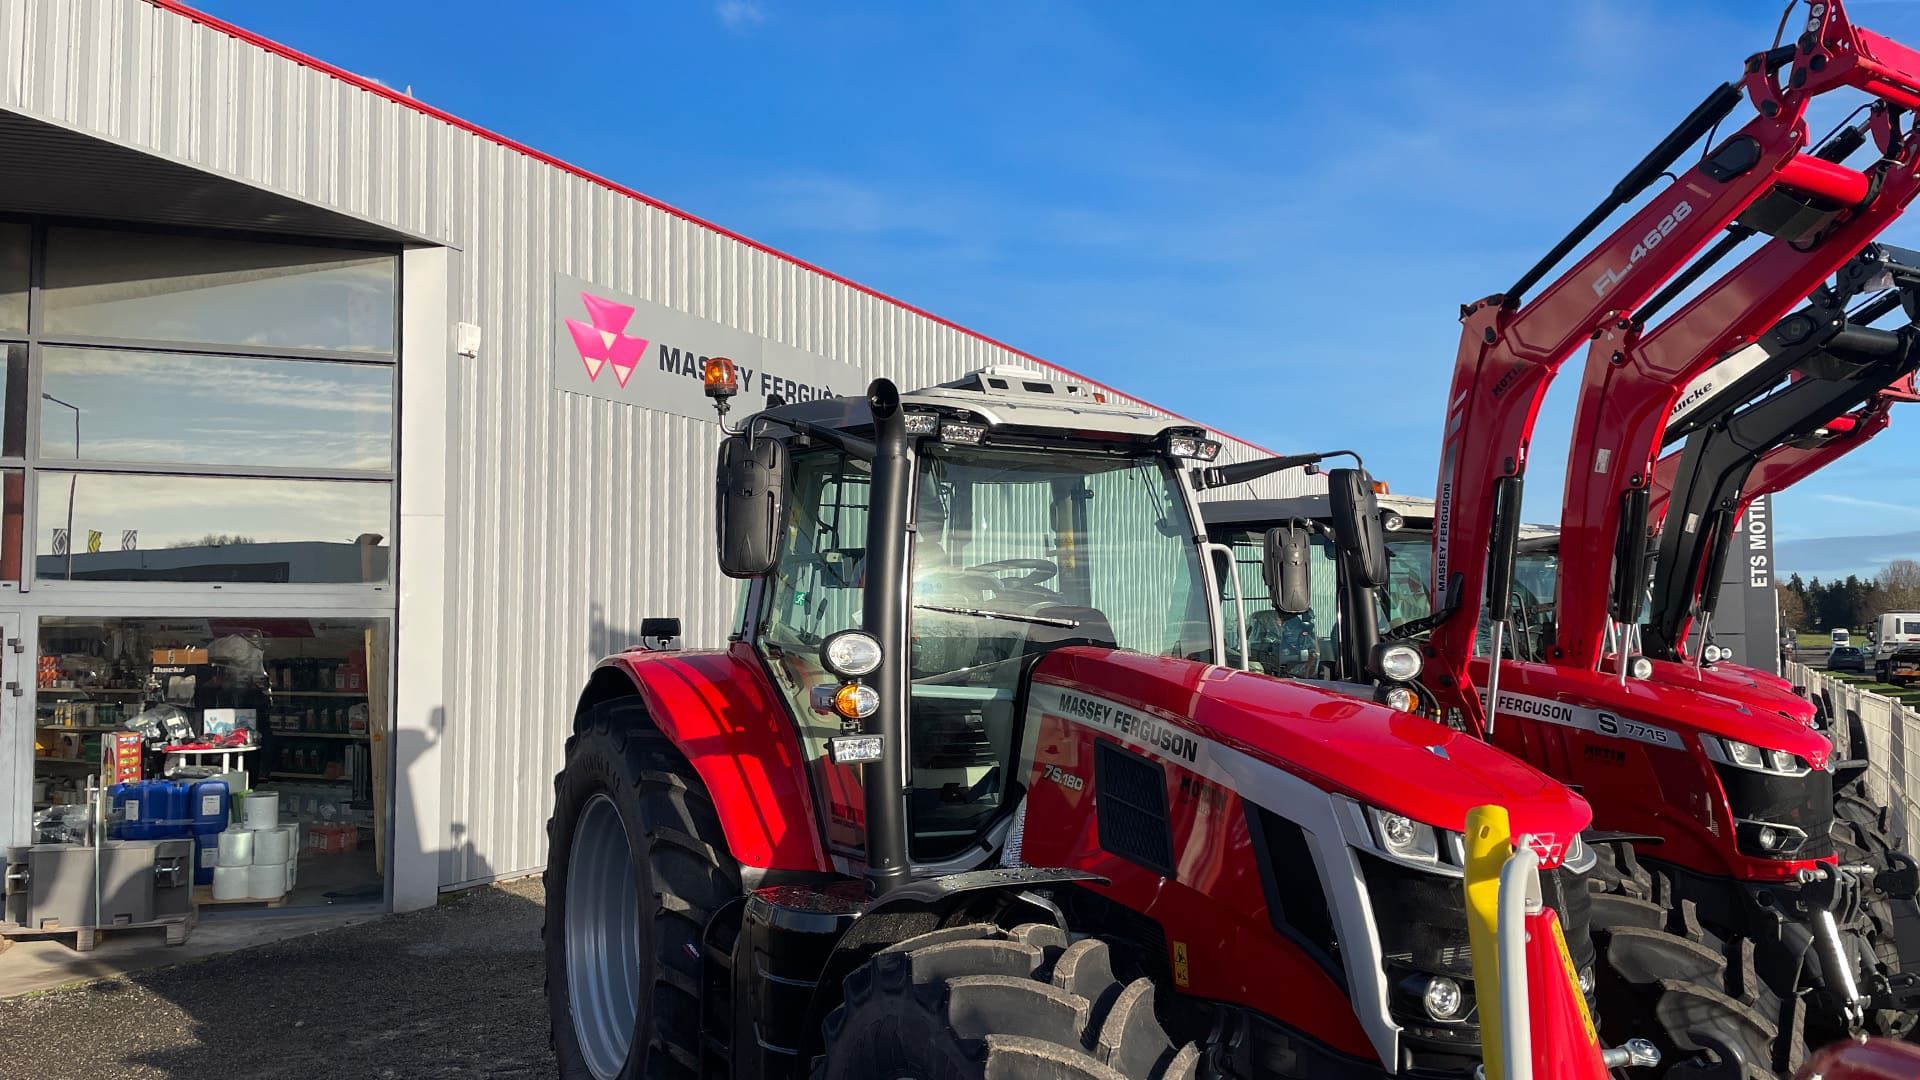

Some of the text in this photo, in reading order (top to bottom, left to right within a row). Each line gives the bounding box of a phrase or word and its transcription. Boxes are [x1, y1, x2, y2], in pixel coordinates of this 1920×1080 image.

[1592, 200, 1692, 298] FL.4628
[659, 343, 843, 404] MASY FERGU
[1671, 382, 1713, 417] uicke
[1438, 483, 1451, 591] MASSEY FERGUSON
[1750, 555, 1768, 588] ETS
[1059, 693, 1198, 763] MASSEY FERGUSON
[1499, 696, 1572, 722] FERGUSON
[1598, 713, 1618, 734] S
[1625, 723, 1667, 742] 7715
